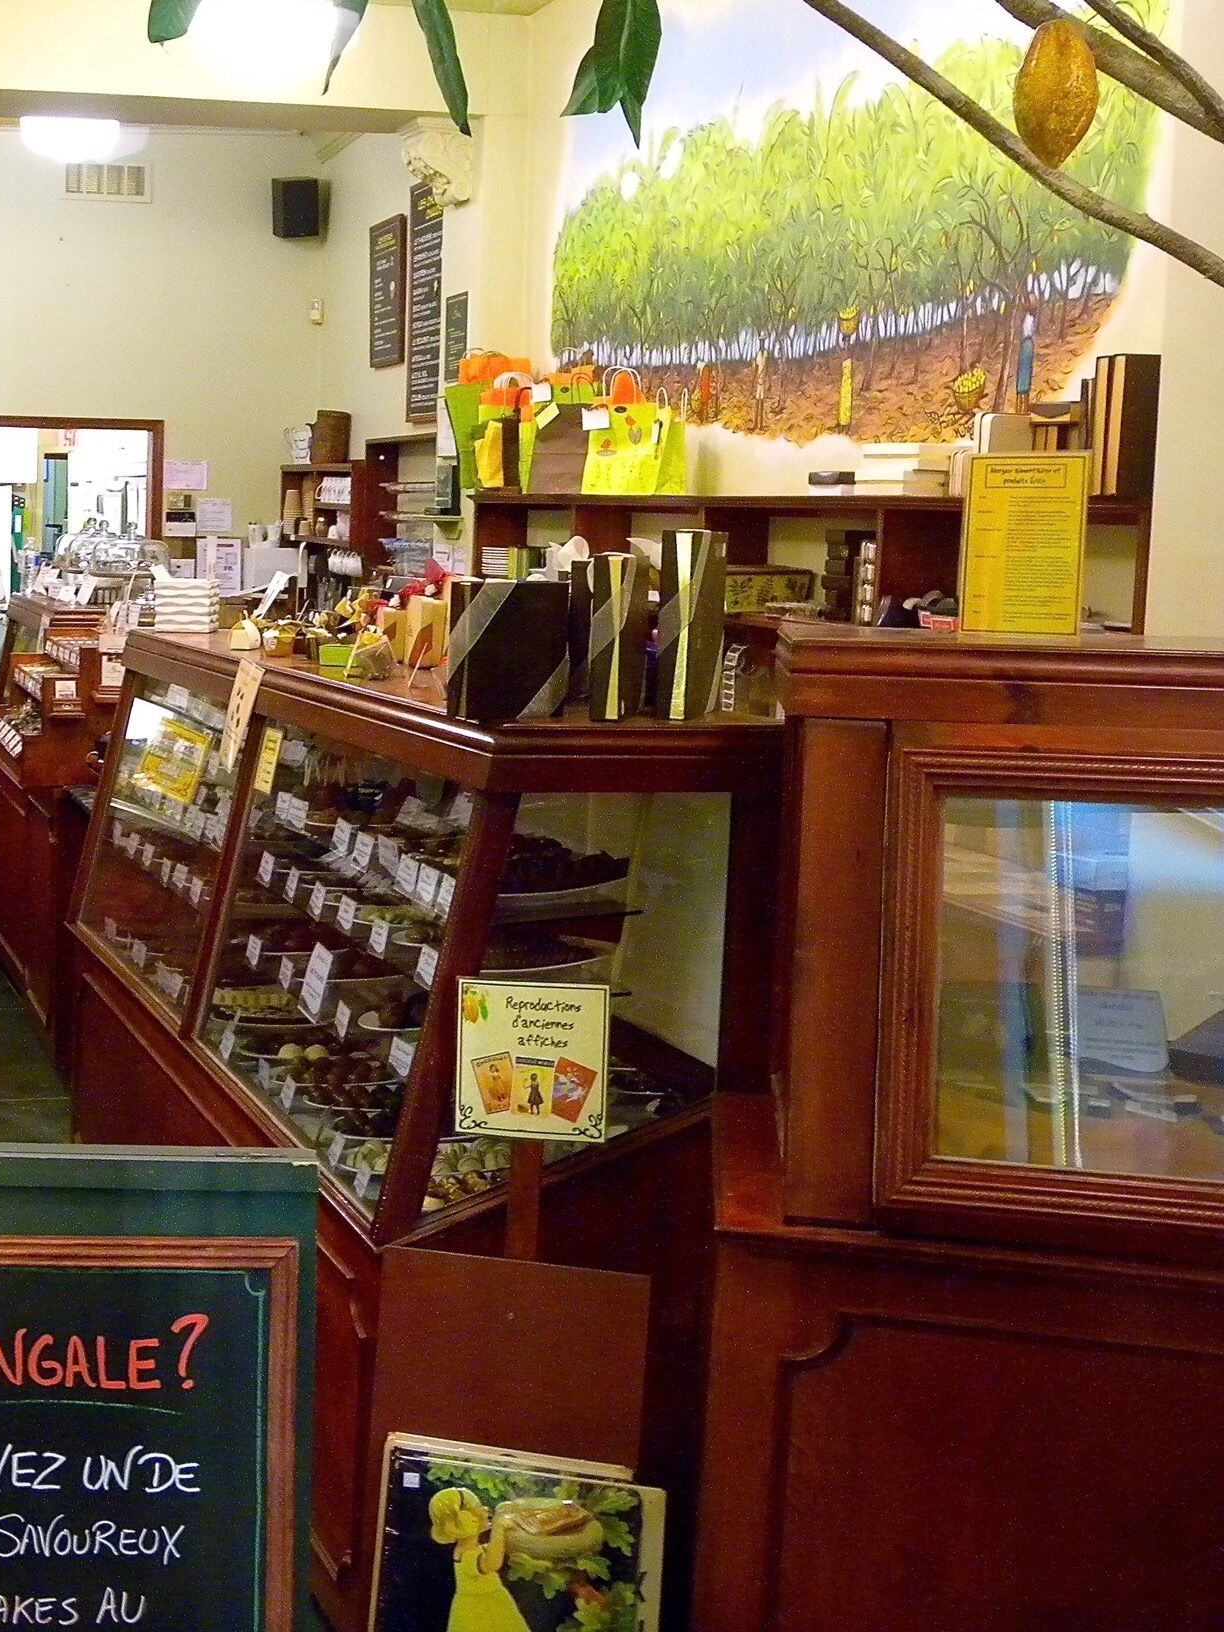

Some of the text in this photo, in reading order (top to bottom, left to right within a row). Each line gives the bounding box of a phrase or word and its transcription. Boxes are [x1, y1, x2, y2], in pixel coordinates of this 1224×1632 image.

[505, 995, 582, 1013] Reproductions
[511, 1014, 575, 1031] d'anciennes
[517, 1033, 569, 1049] affiches
[96, 1586, 147, 1625] AU
